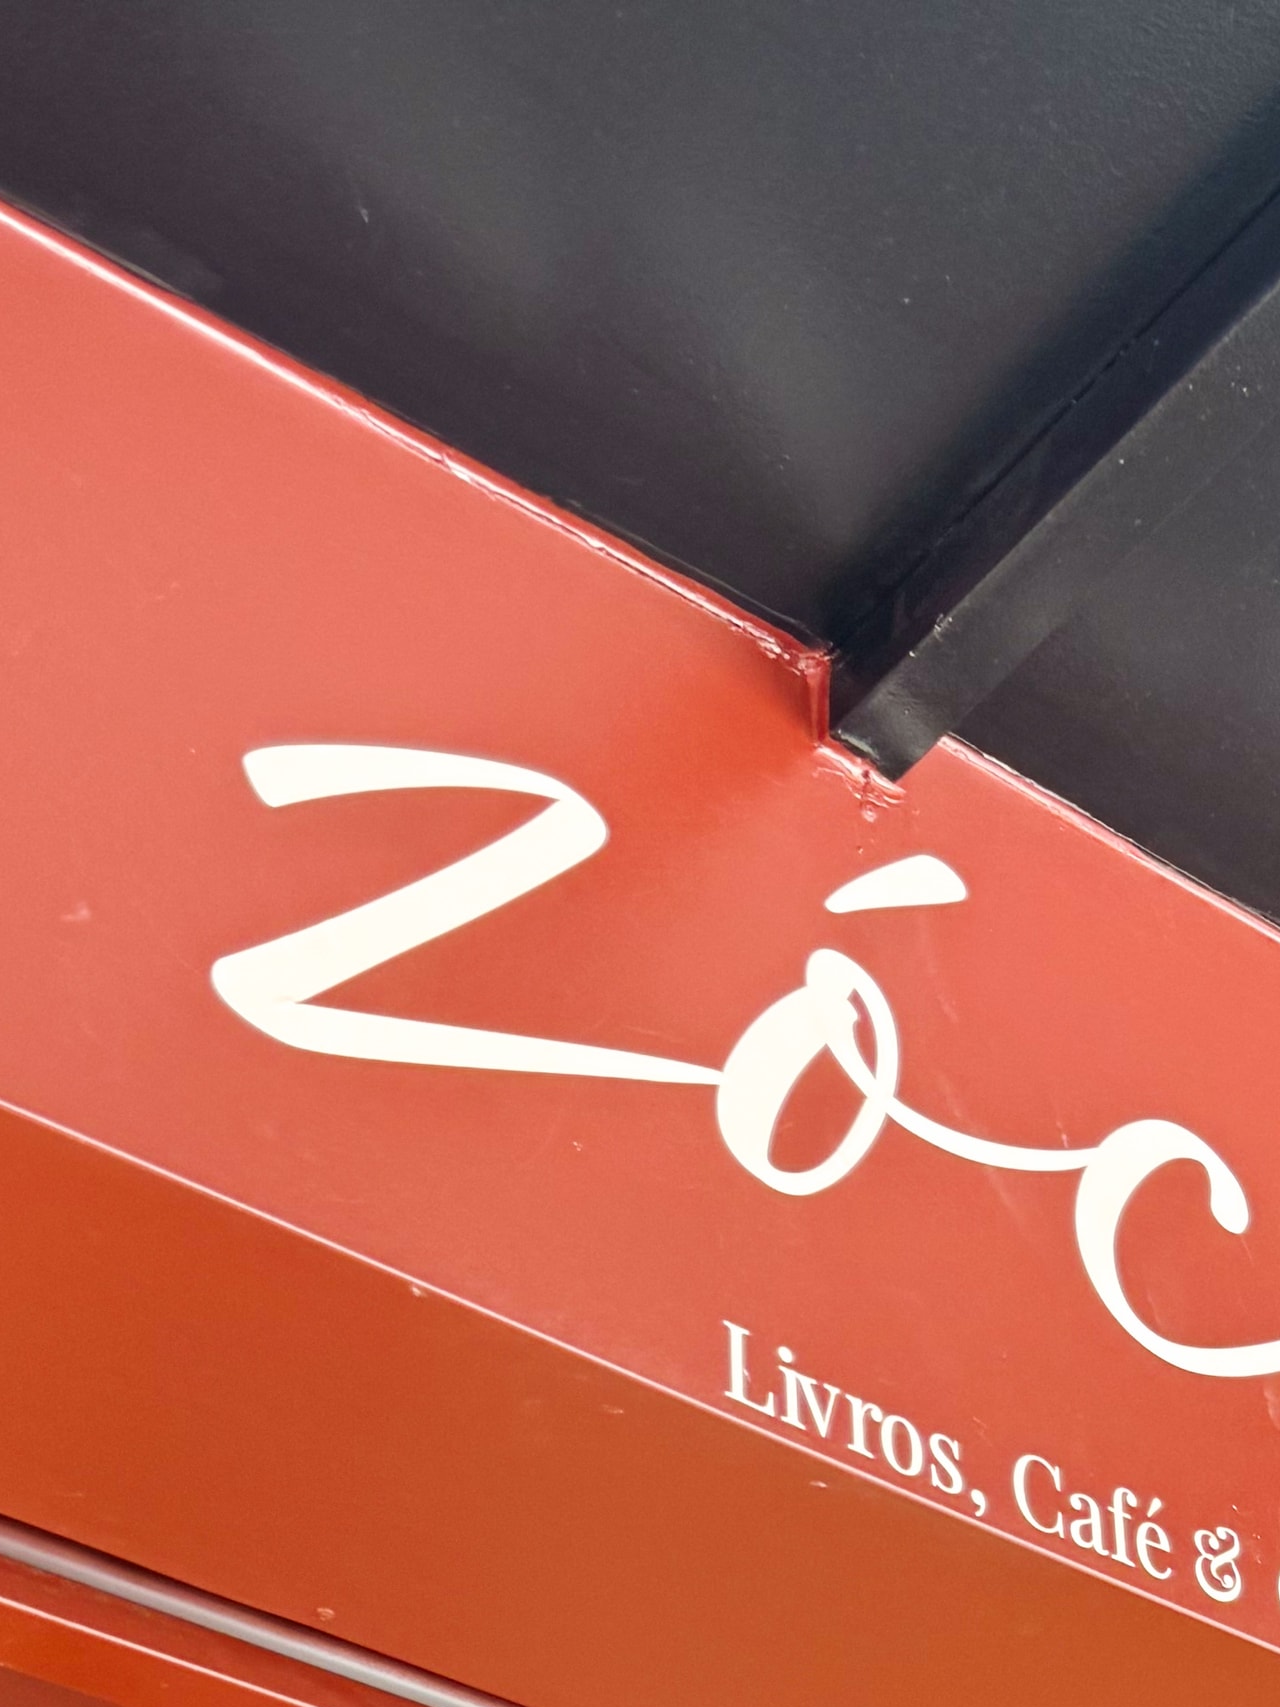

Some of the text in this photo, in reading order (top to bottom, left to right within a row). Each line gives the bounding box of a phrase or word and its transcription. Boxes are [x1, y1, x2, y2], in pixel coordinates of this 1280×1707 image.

[722, 1319, 987, 1517] Livros,
[1013, 1454, 1172, 1580] Café
[1193, 1526, 1242, 1603] &
